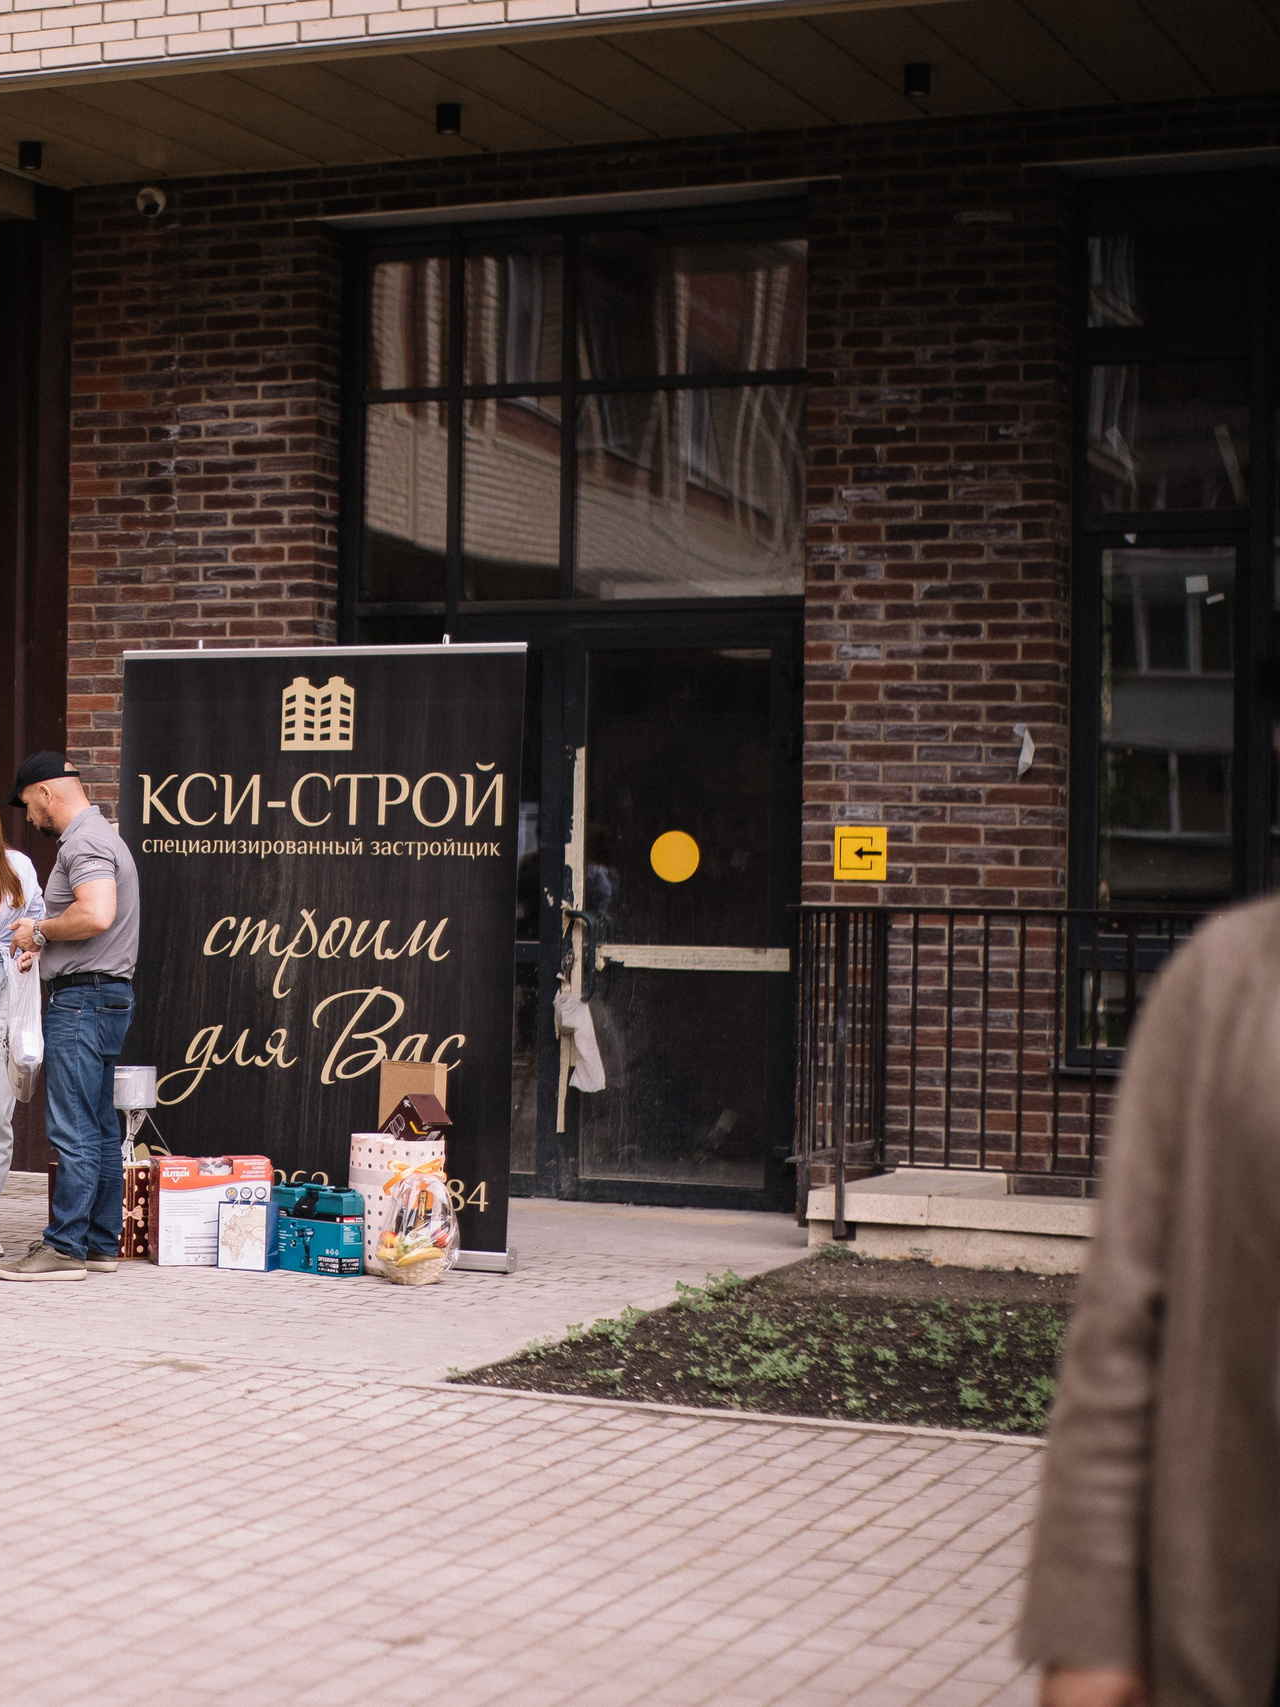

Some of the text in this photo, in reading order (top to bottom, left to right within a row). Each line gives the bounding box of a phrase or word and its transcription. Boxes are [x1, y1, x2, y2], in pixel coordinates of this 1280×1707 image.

[138, 762, 504, 827] КСИ-СТРОЙ
[142, 837, 501, 860] специализированный застройщик
[203, 909, 451, 999] строим
[155, 986, 466, 1105] для Вас
[162, 1170, 191, 1178] ELITECH
